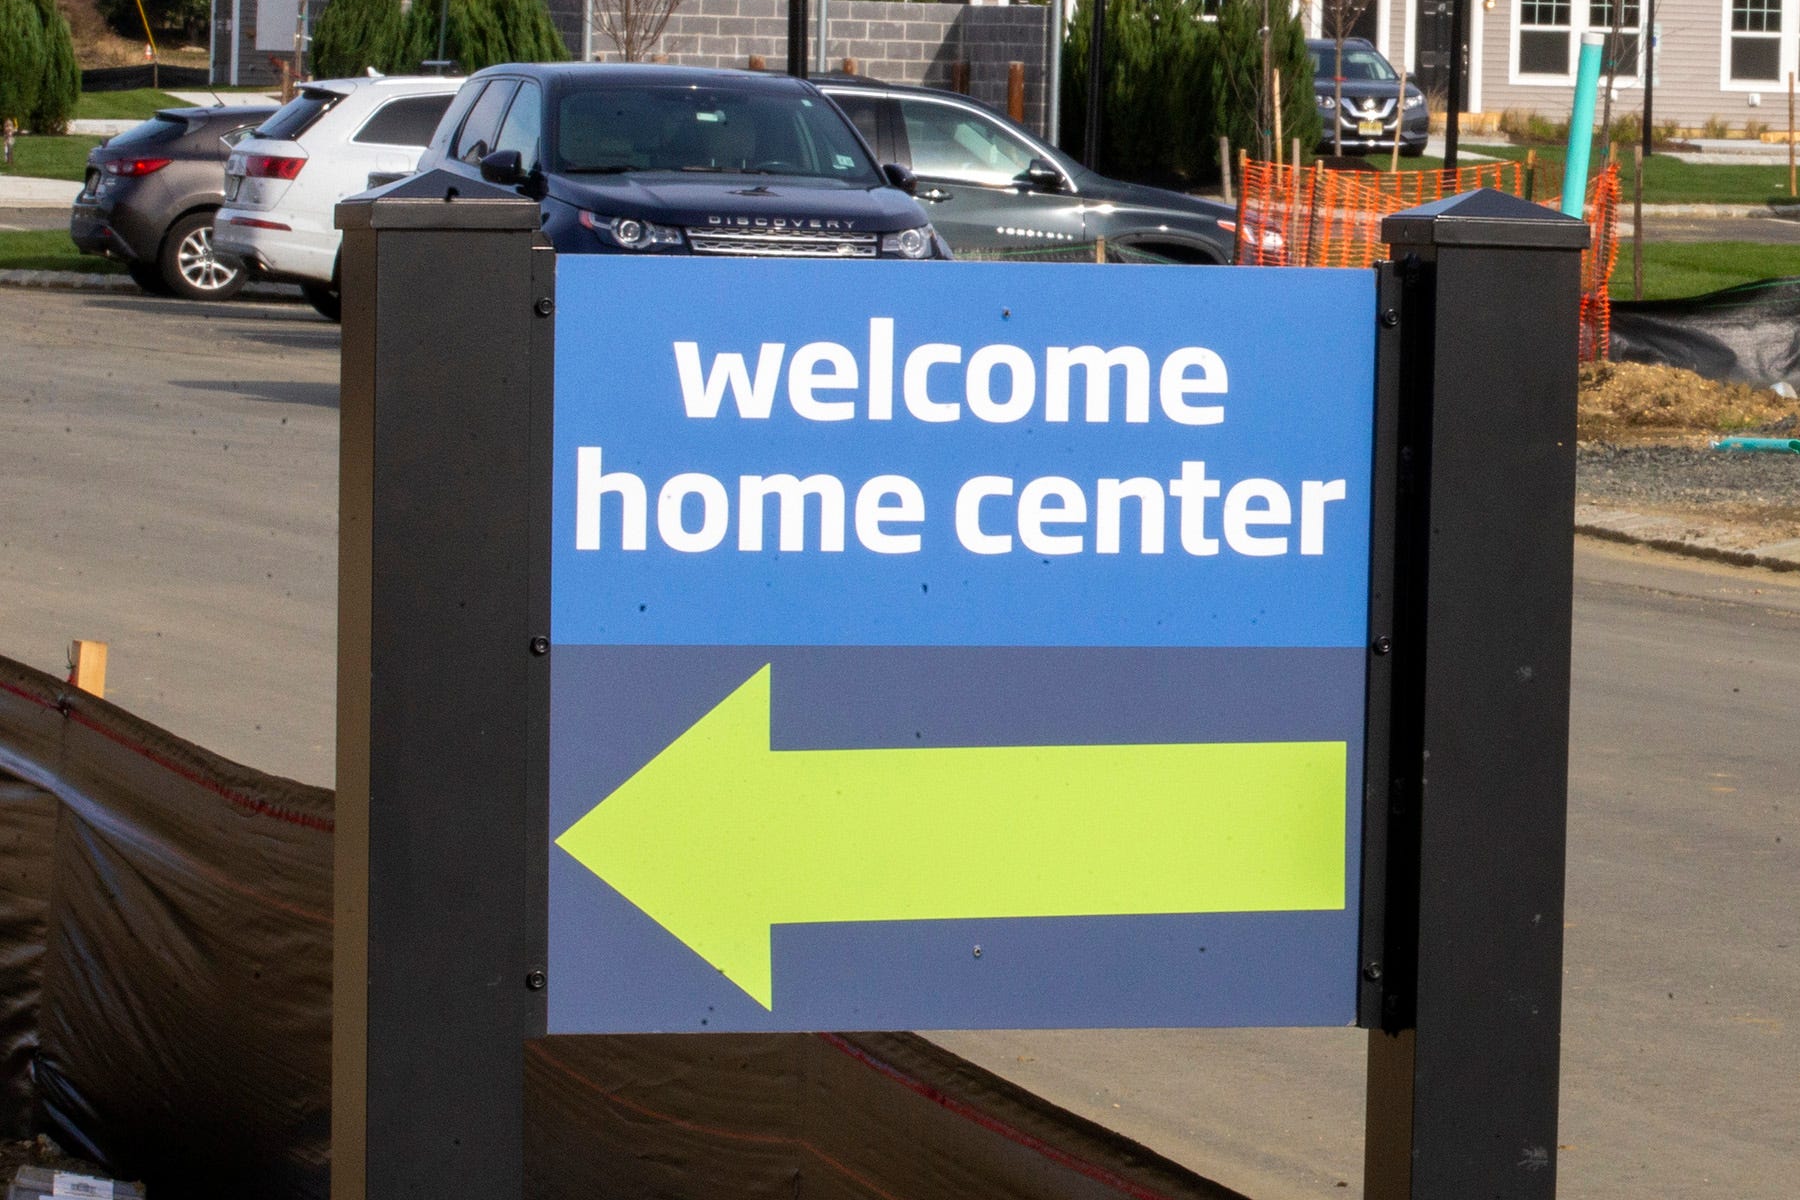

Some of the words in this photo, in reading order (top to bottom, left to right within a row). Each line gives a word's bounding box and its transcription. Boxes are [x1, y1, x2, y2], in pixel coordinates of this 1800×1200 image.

[708, 205, 855, 229] DISCOVERY
[674, 318, 1227, 425] welcome
[577, 447, 924, 553] home
[956, 462, 1345, 556] center
